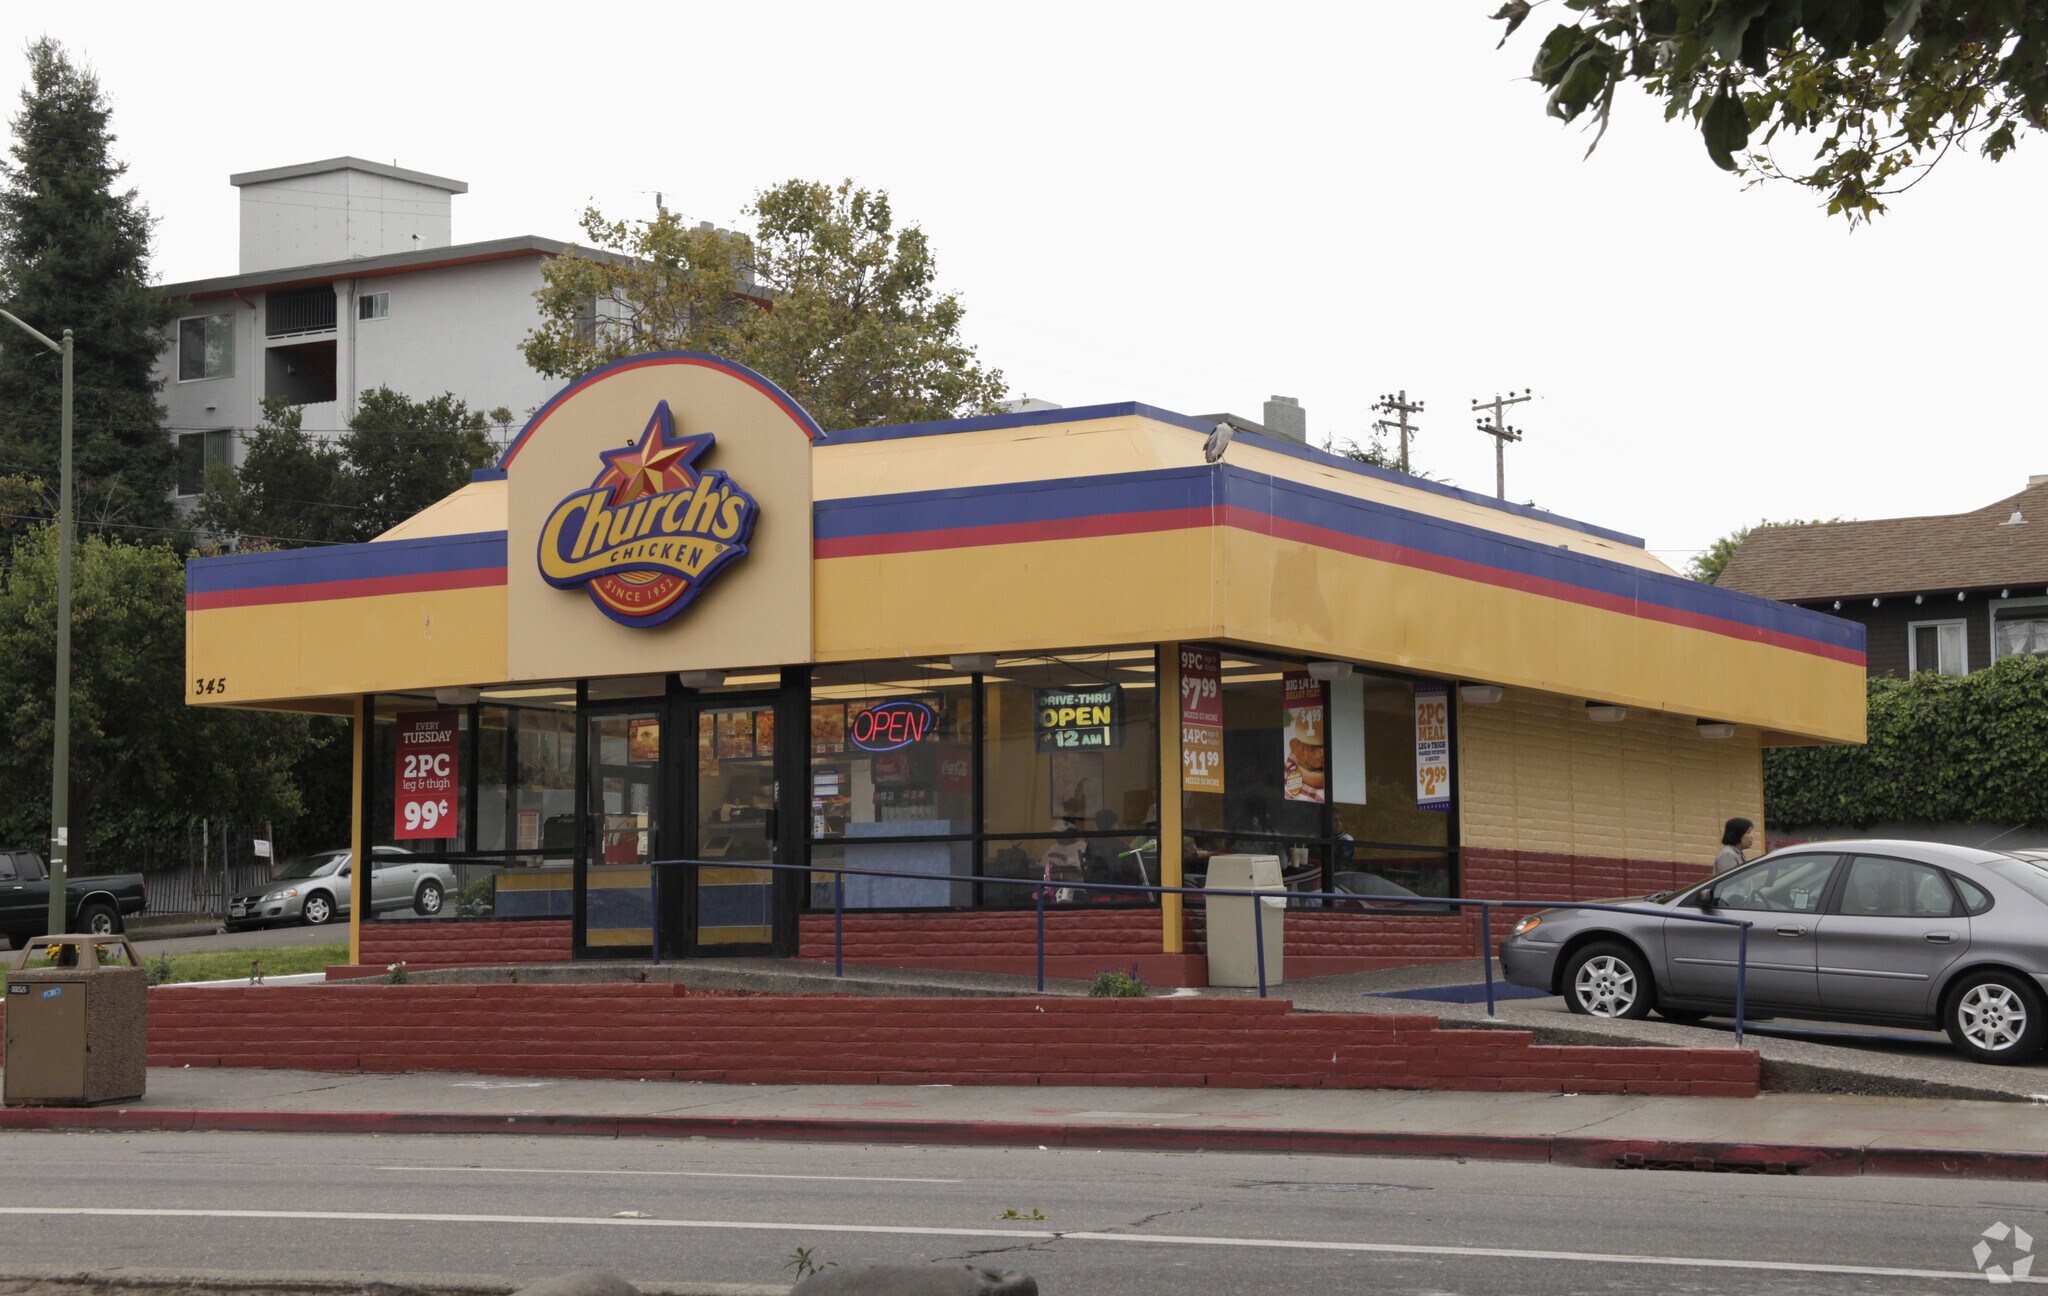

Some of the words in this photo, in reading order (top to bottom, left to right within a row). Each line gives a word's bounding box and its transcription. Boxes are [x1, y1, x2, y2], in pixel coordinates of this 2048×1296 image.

[540, 476, 746, 579] Church's
[610, 543, 703, 569] CHICKEN
[605, 580, 640, 602] SINCE
[647, 579, 673, 599] 1952
[1181, 651, 1203, 670] 9PC
[196, 678, 226, 695] 345
[1285, 680, 1298, 691] BIG
[1299, 678, 1309, 690] 1/4
[1040, 693, 1112, 706] DRIVE-THRU
[1041, 706, 1111, 728] OPEN
[1418, 703, 1445, 726] 2PC
[415, 722, 440, 731] EVERY
[854, 711, 925, 742] OPEN
[1418, 726, 1445, 741] MEAL
[403, 731, 452, 744] TUESDAY
[1056, 730, 1079, 747] 12
[1081, 734, 1102, 745] AM
[1183, 728, 1208, 745] 14PC
[404, 754, 450, 778] 2PC
[403, 780, 417, 792] leg
[418, 779, 425, 789] &
[426, 778, 451, 791] thigh
[404, 799, 449, 831] 99¢
